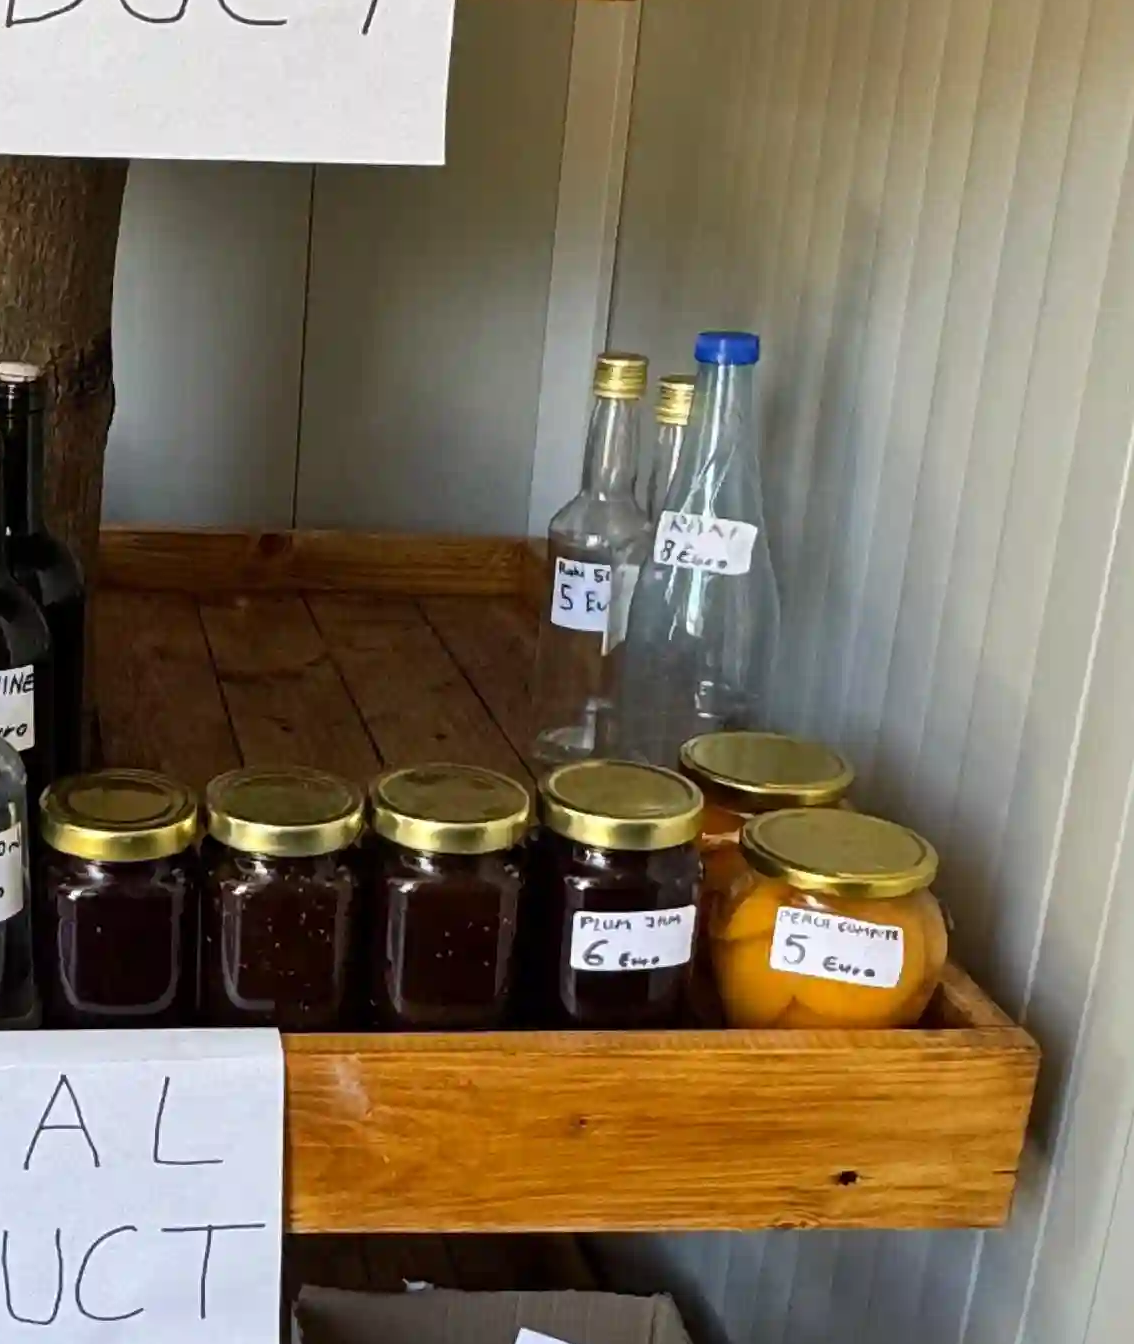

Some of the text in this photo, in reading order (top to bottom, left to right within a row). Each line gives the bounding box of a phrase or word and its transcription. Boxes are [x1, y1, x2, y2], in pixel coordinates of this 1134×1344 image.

[560, 584, 574, 611] 5
[580, 914, 681, 931] PLUM JAM
[778, 910, 830, 929] PEACH
[582, 939, 660, 967] 6 Euro
[784, 934, 876, 978] 5 Euro
